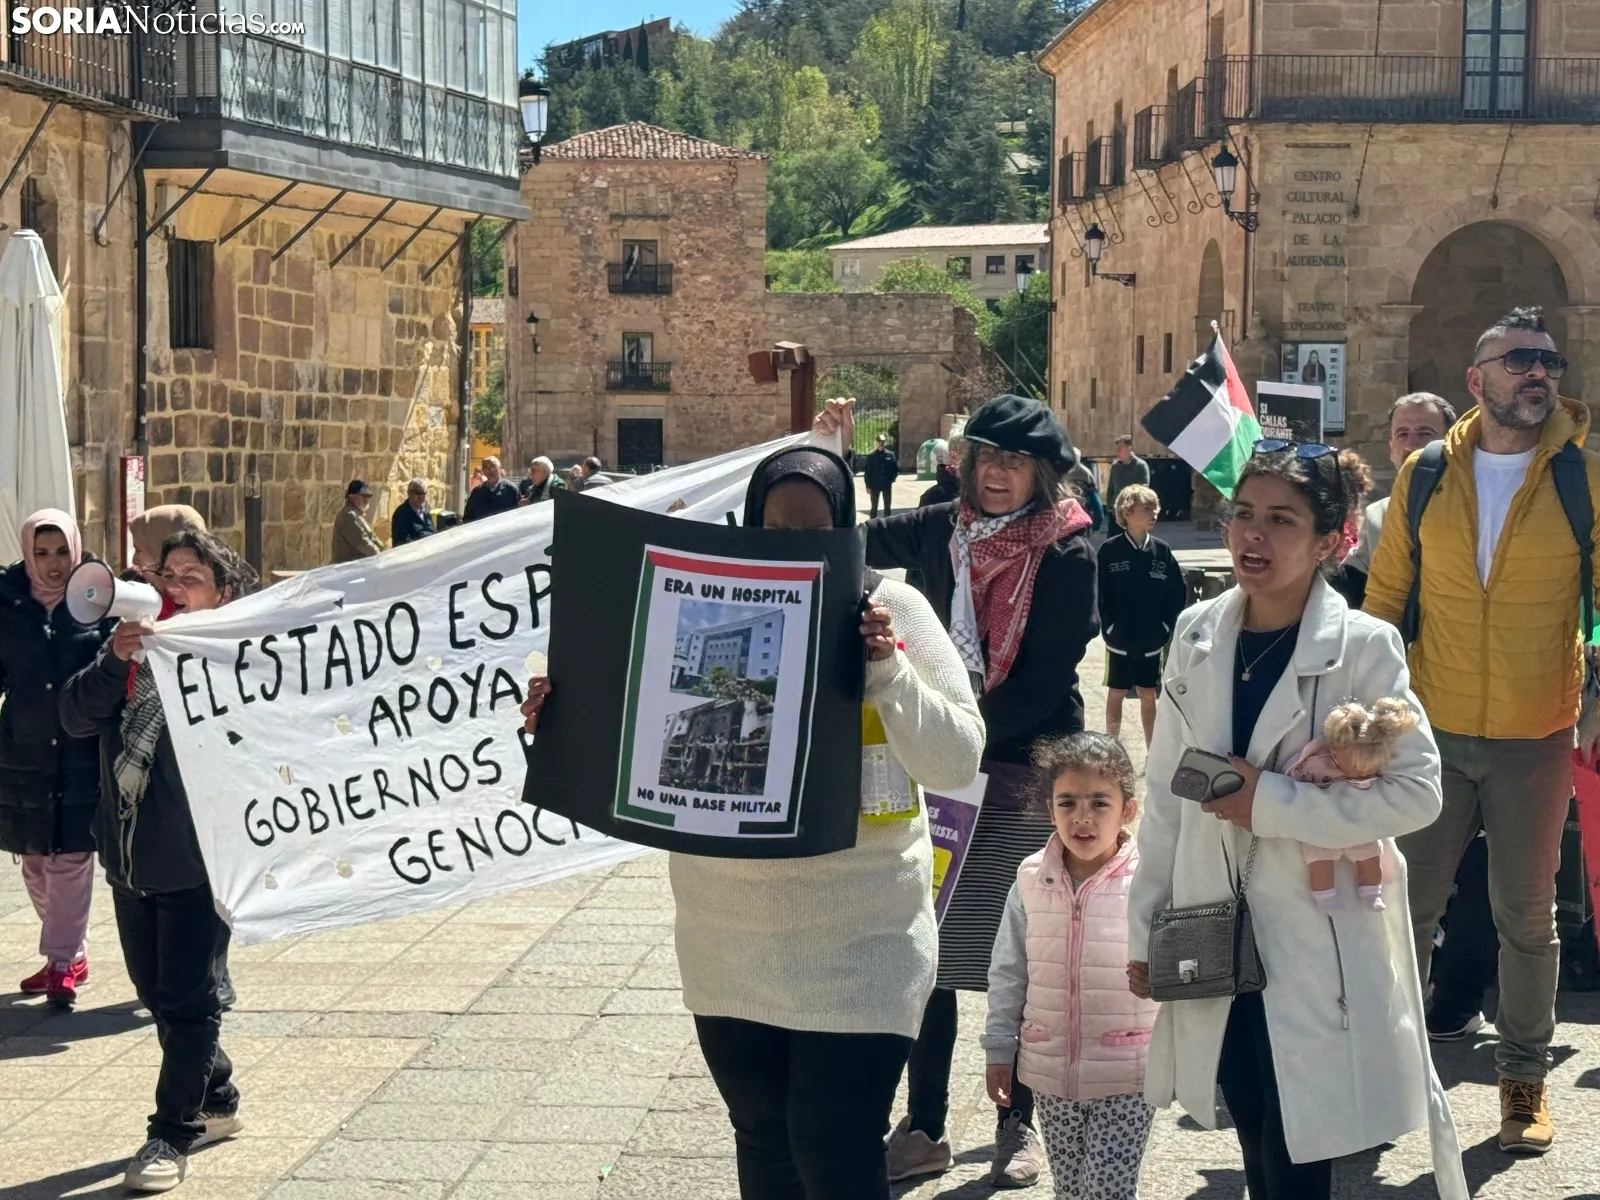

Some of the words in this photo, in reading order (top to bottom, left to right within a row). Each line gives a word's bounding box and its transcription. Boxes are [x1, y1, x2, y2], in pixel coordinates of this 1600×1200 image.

[1294, 170, 1341, 182] CENTRO
[1286, 191, 1348, 204] CULTURAL
[1292, 213, 1341, 225] PALACIO
[1293, 234, 1309, 246] DE
[1323, 234, 1340, 246] LA
[1285, 255, 1346, 267] AUDIENCIA
[1297, 302, 1334, 313] TEATRO
[1283, 321, 1347, 332] EXPOSICIONES
[1260, 403, 1268, 415] SI
[1260, 415, 1287, 428] CALLAS
[664, 577, 694, 597] ERA
[701, 584, 726, 600] UN
[732, 586, 802, 605] HOSPITAL
[176, 652, 229, 727] EL
[233, 601, 421, 705] ESTADO
[368, 662, 525, 747] APOYA
[244, 737, 502, 848] GOBIERNOS
[637, 786, 655, 801] NO
[659, 791, 687, 808] UNA
[692, 797, 726, 812] BASE
[730, 799, 782, 814] MILITAR
